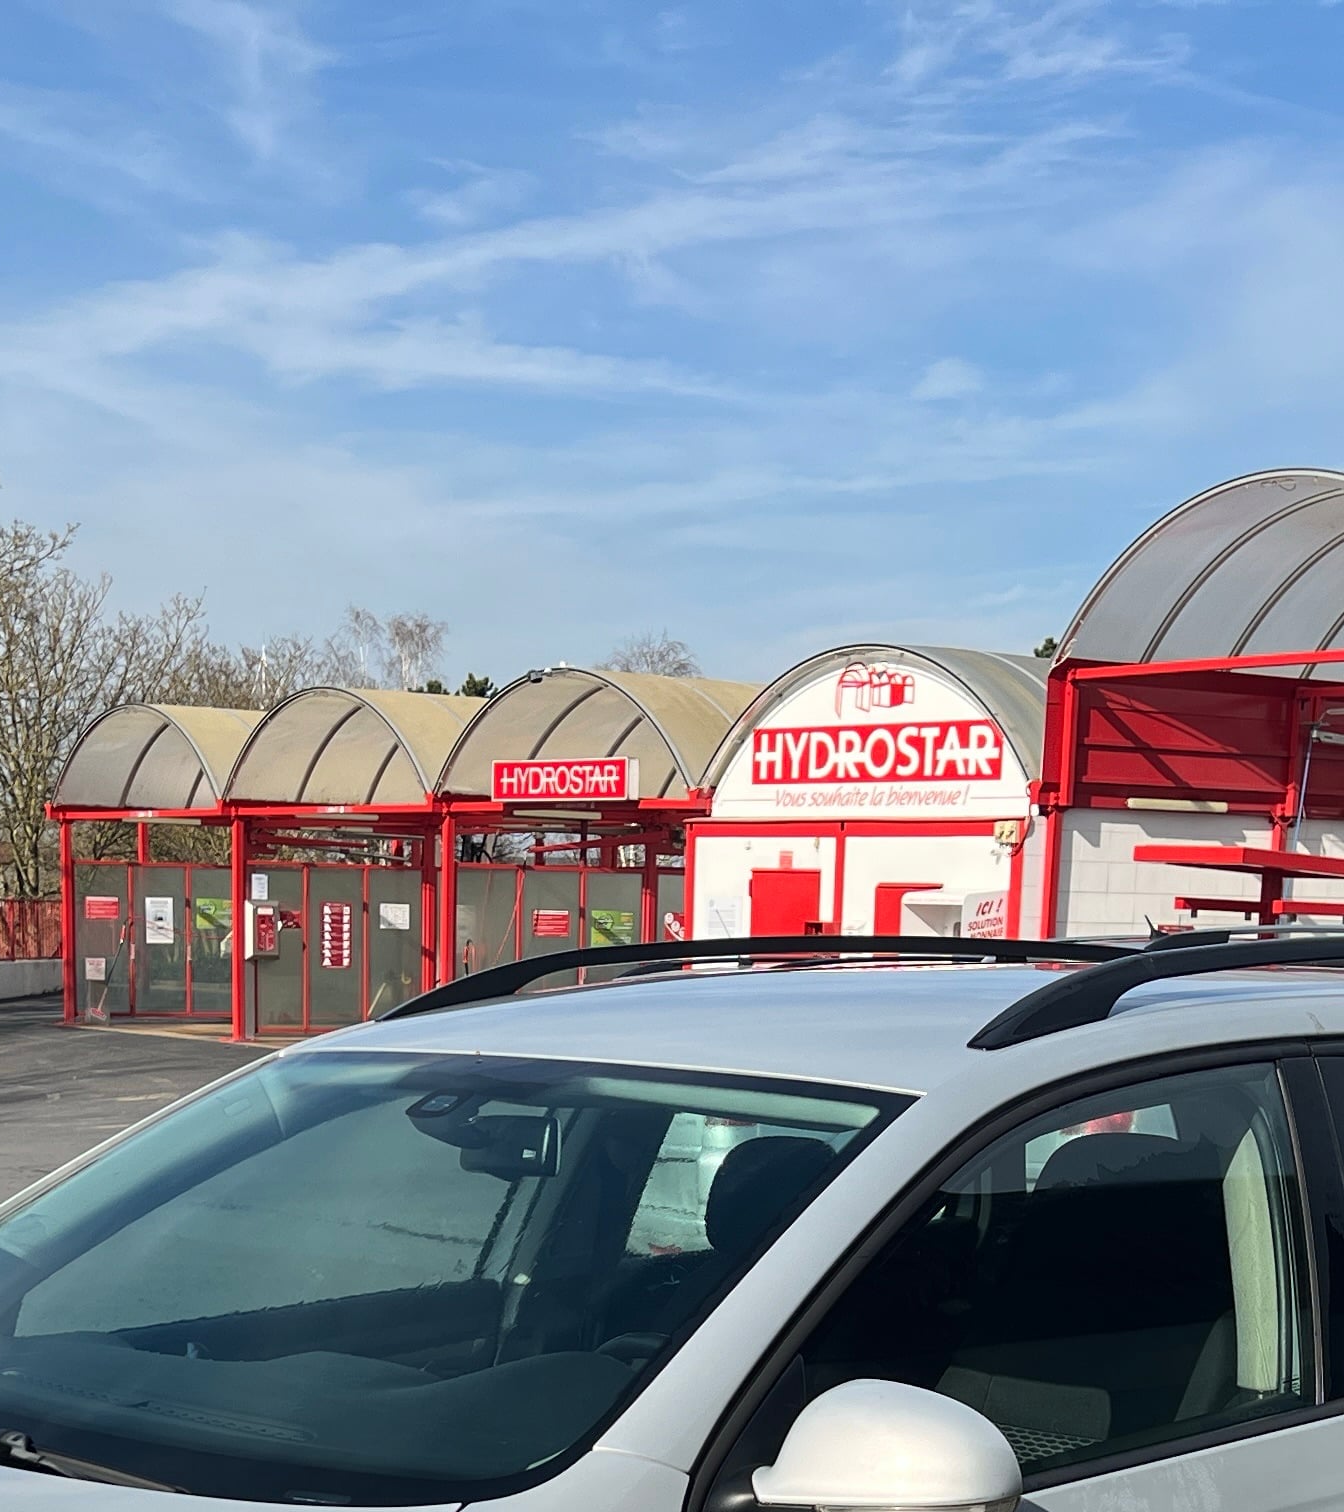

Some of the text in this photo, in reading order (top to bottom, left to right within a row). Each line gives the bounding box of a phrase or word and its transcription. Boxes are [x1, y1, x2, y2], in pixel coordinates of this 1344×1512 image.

[754, 725, 1000, 780] HYDROSTAR
[500, 765, 620, 795] HYDROSTAR
[775, 788, 807, 807] Vous
[808, 785, 867, 807] souhaite
[869, 786, 887, 806] la
[887, 785, 962, 806] bienvenue
[975, 900, 994, 917] ICI
[967, 917, 1004, 931] SOLUTION
